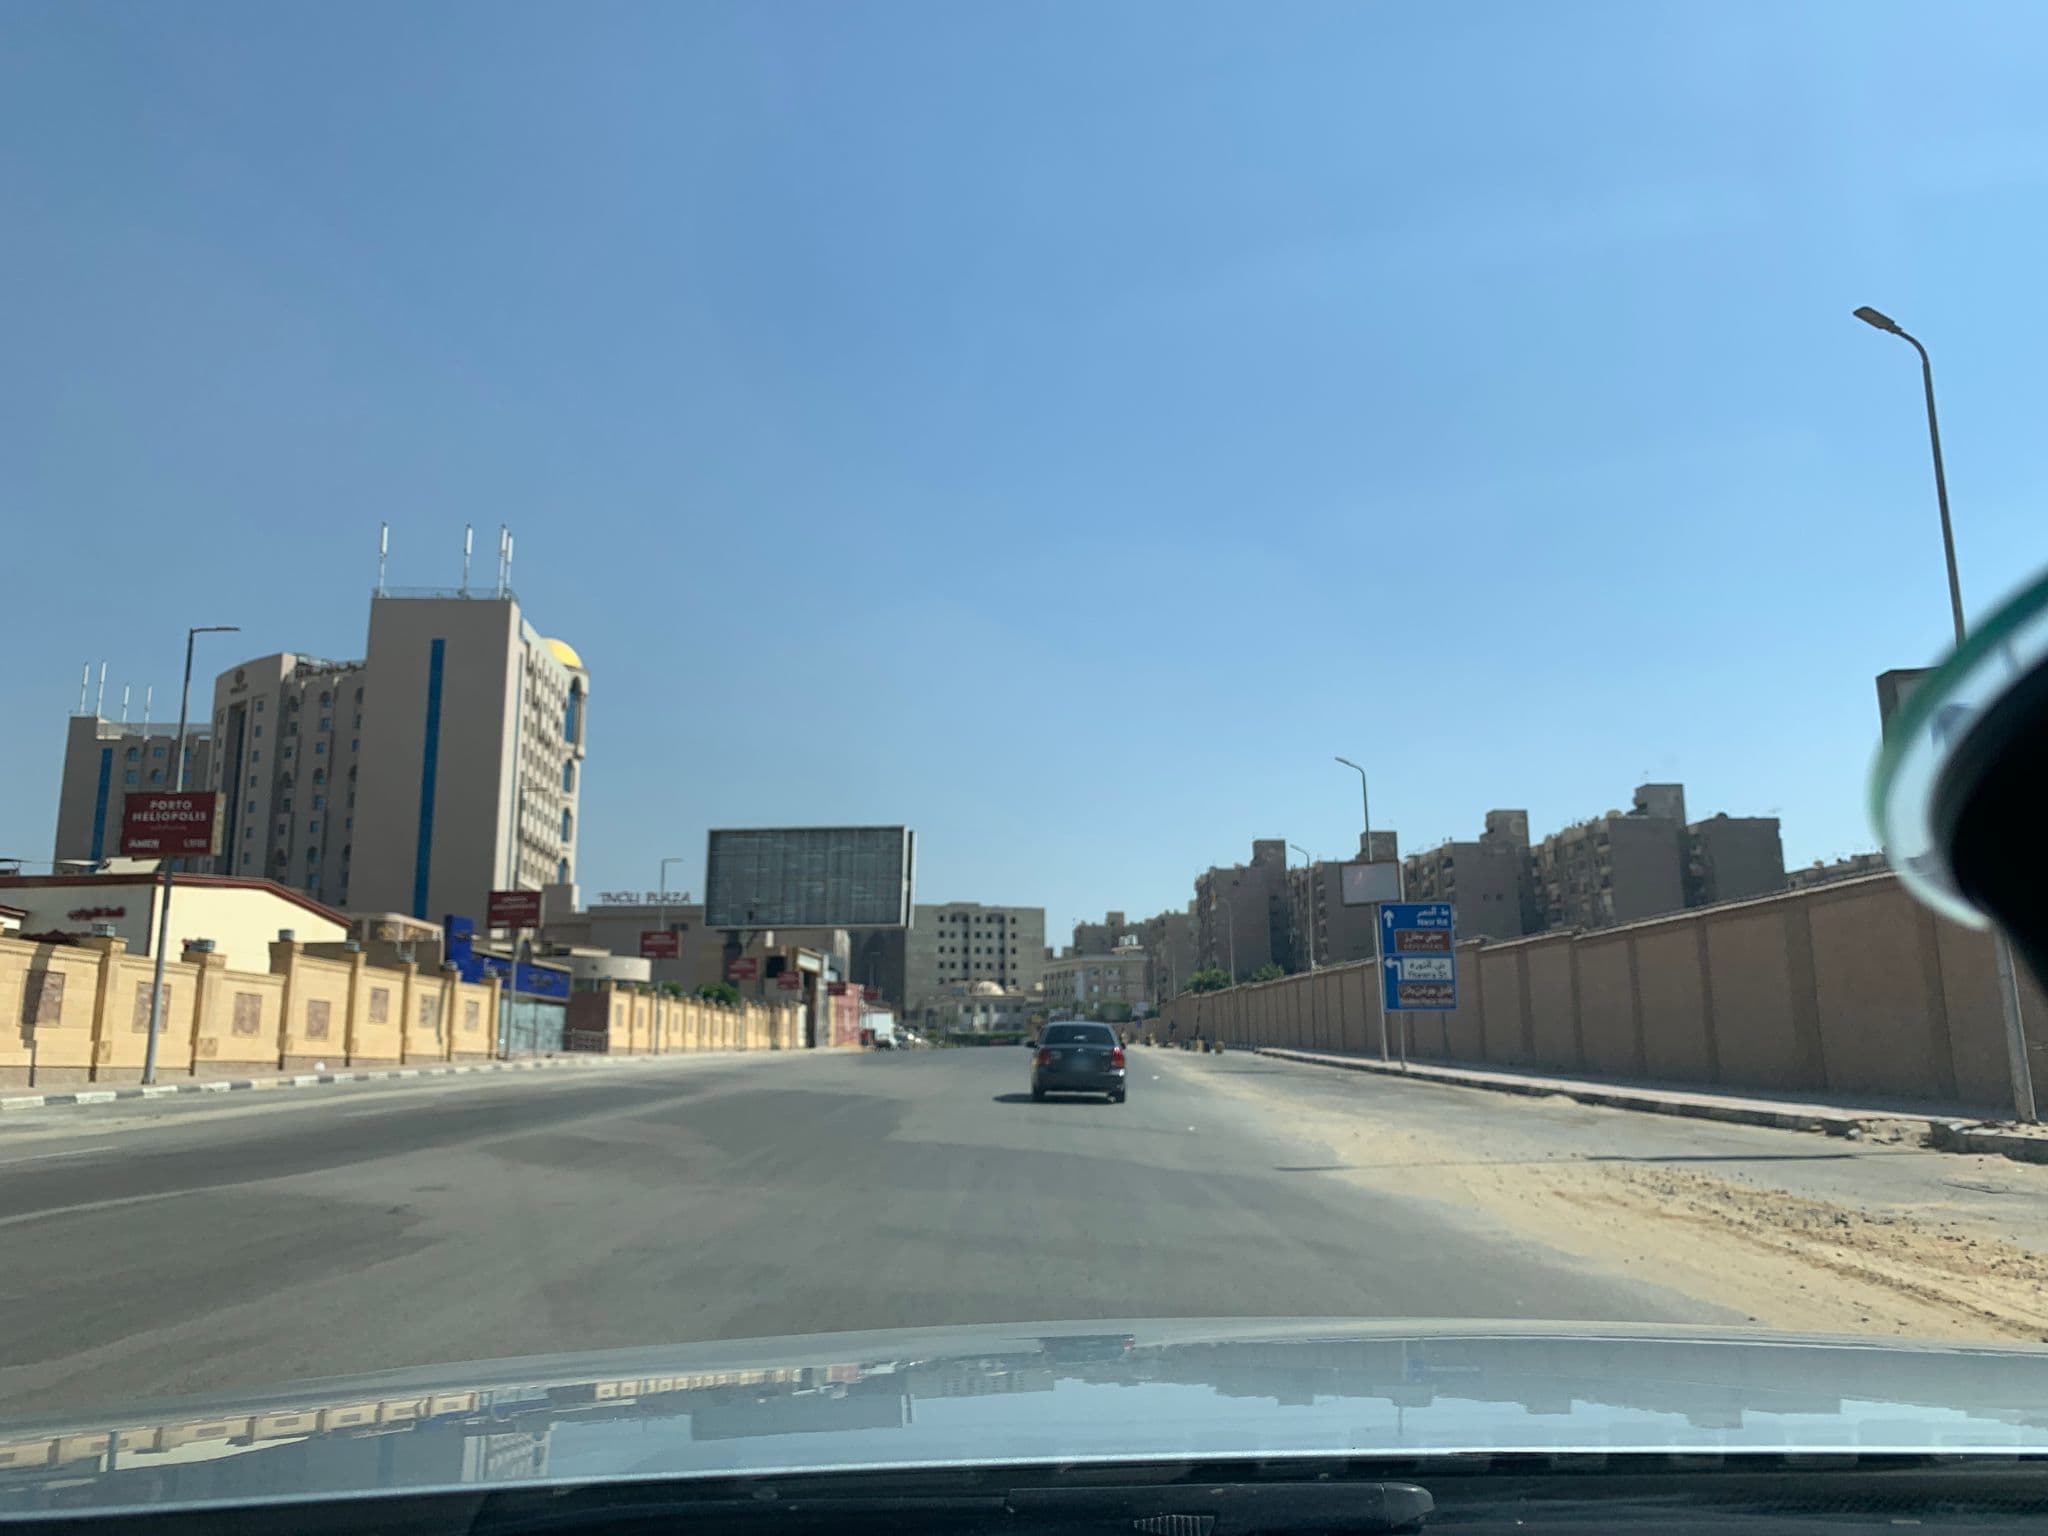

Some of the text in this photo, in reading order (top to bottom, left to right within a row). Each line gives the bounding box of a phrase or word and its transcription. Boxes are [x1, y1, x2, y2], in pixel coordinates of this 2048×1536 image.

[149, 800, 193, 810] PORTO
[131, 811, 208, 822] HELIOPOLIS
[645, 890, 691, 905] PLAZA
